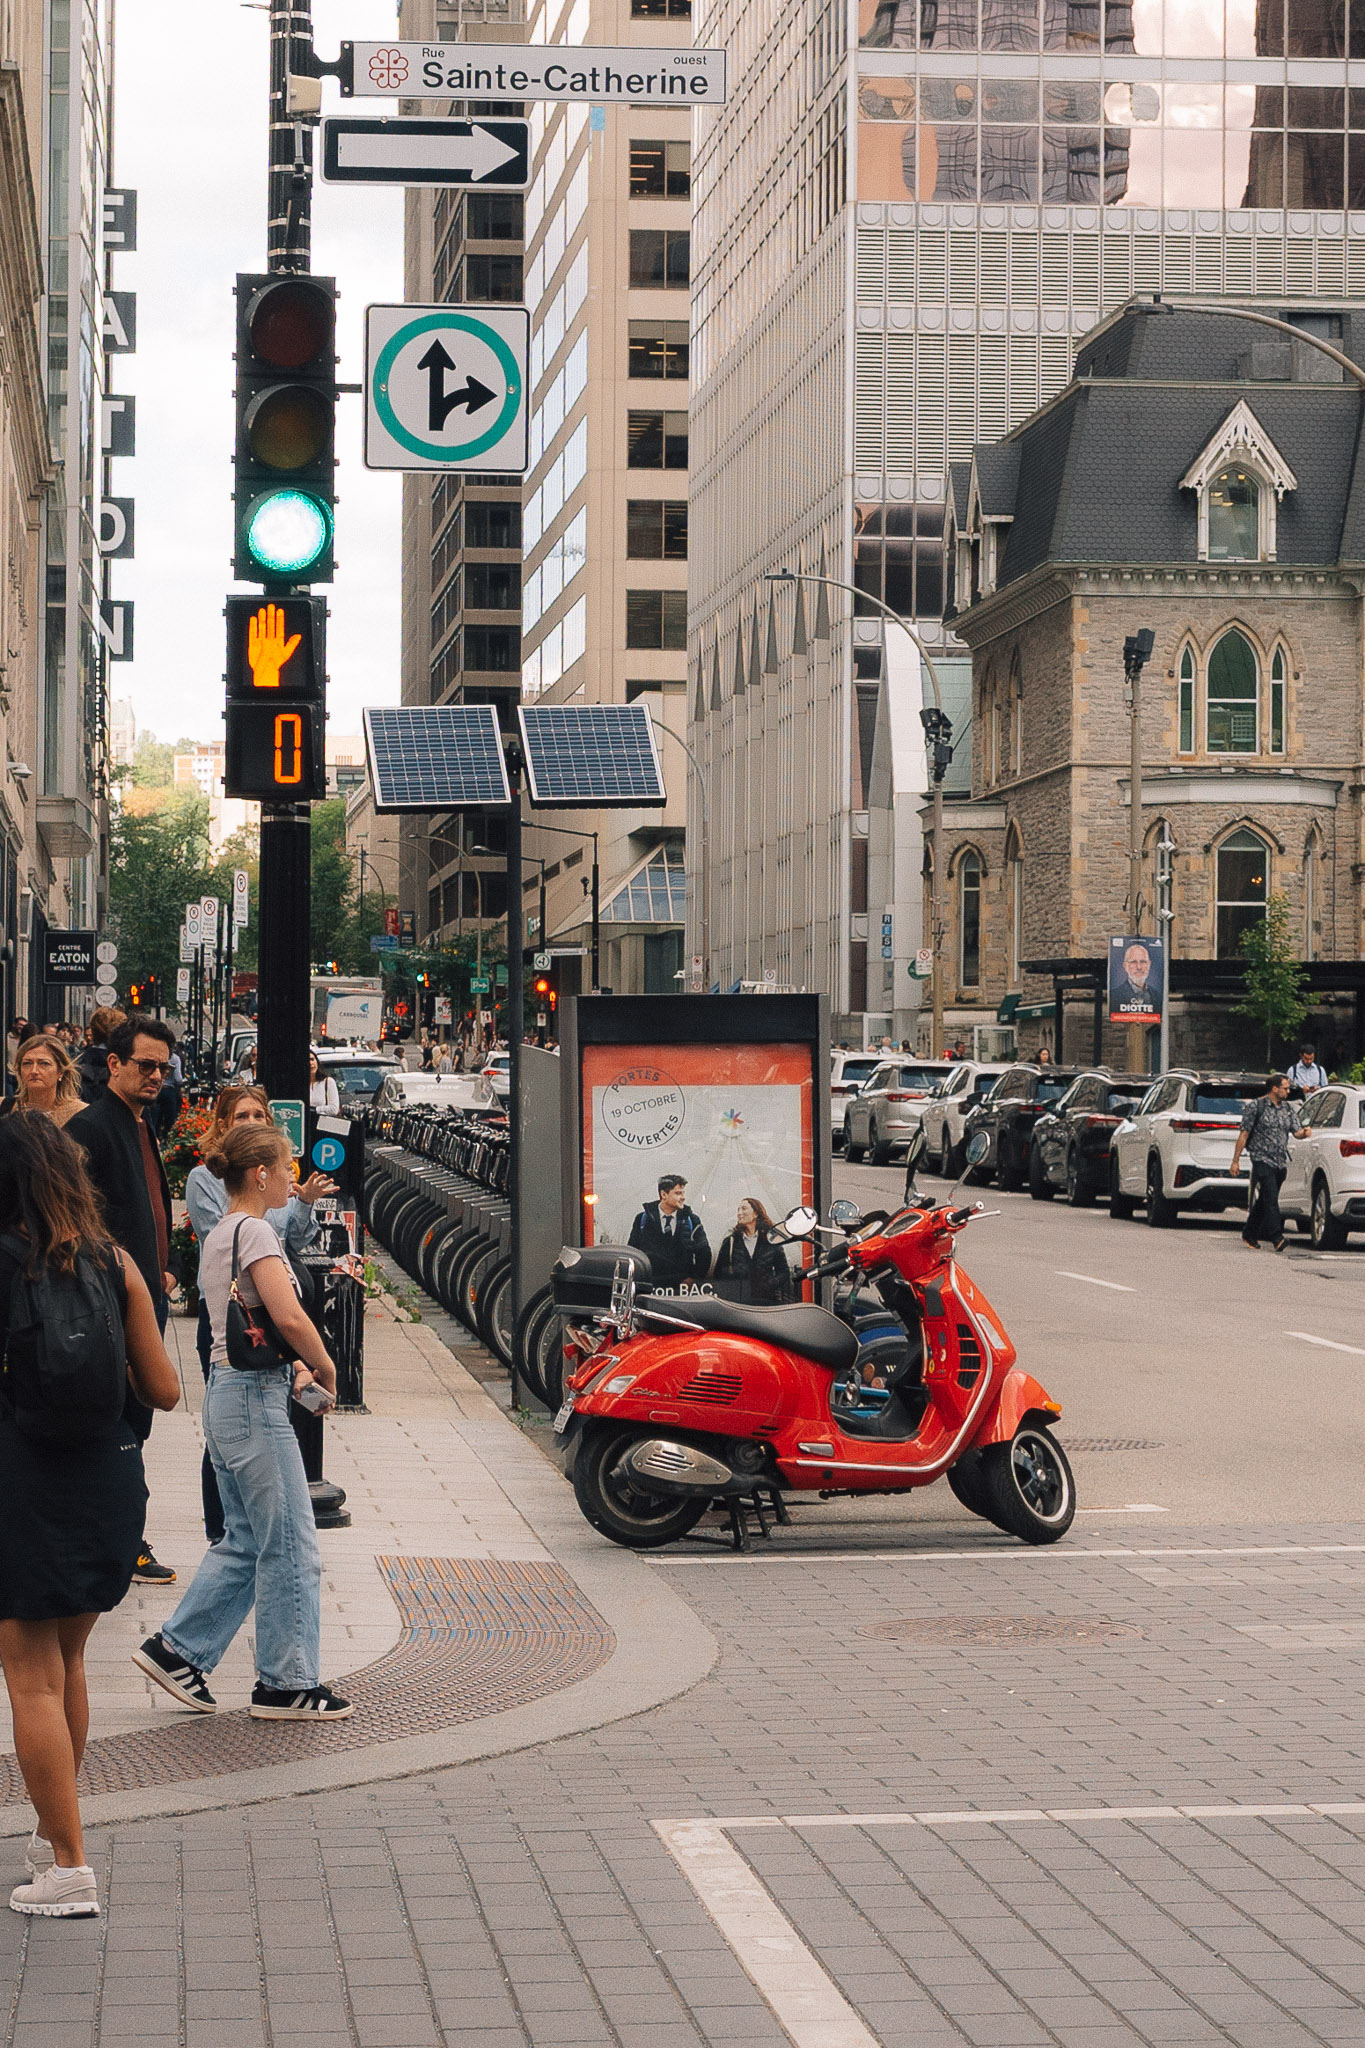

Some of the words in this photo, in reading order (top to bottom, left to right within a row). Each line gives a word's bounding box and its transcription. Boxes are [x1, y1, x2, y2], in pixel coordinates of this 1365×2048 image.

[422, 47, 445, 58] Rue
[673, 54, 707, 65] ouest
[422, 61, 709, 96] Sainte-Catherine
[274, 713, 302, 784] 0
[49, 952, 90, 964] EATON
[1120, 1004, 1154, 1012] DIOTTE
[611, 1069, 661, 1093] PORTES
[611, 1108, 622, 1118] 19
[624, 1092, 678, 1115] OCTOBRE
[618, 1114, 679, 1145] OUVERTES
